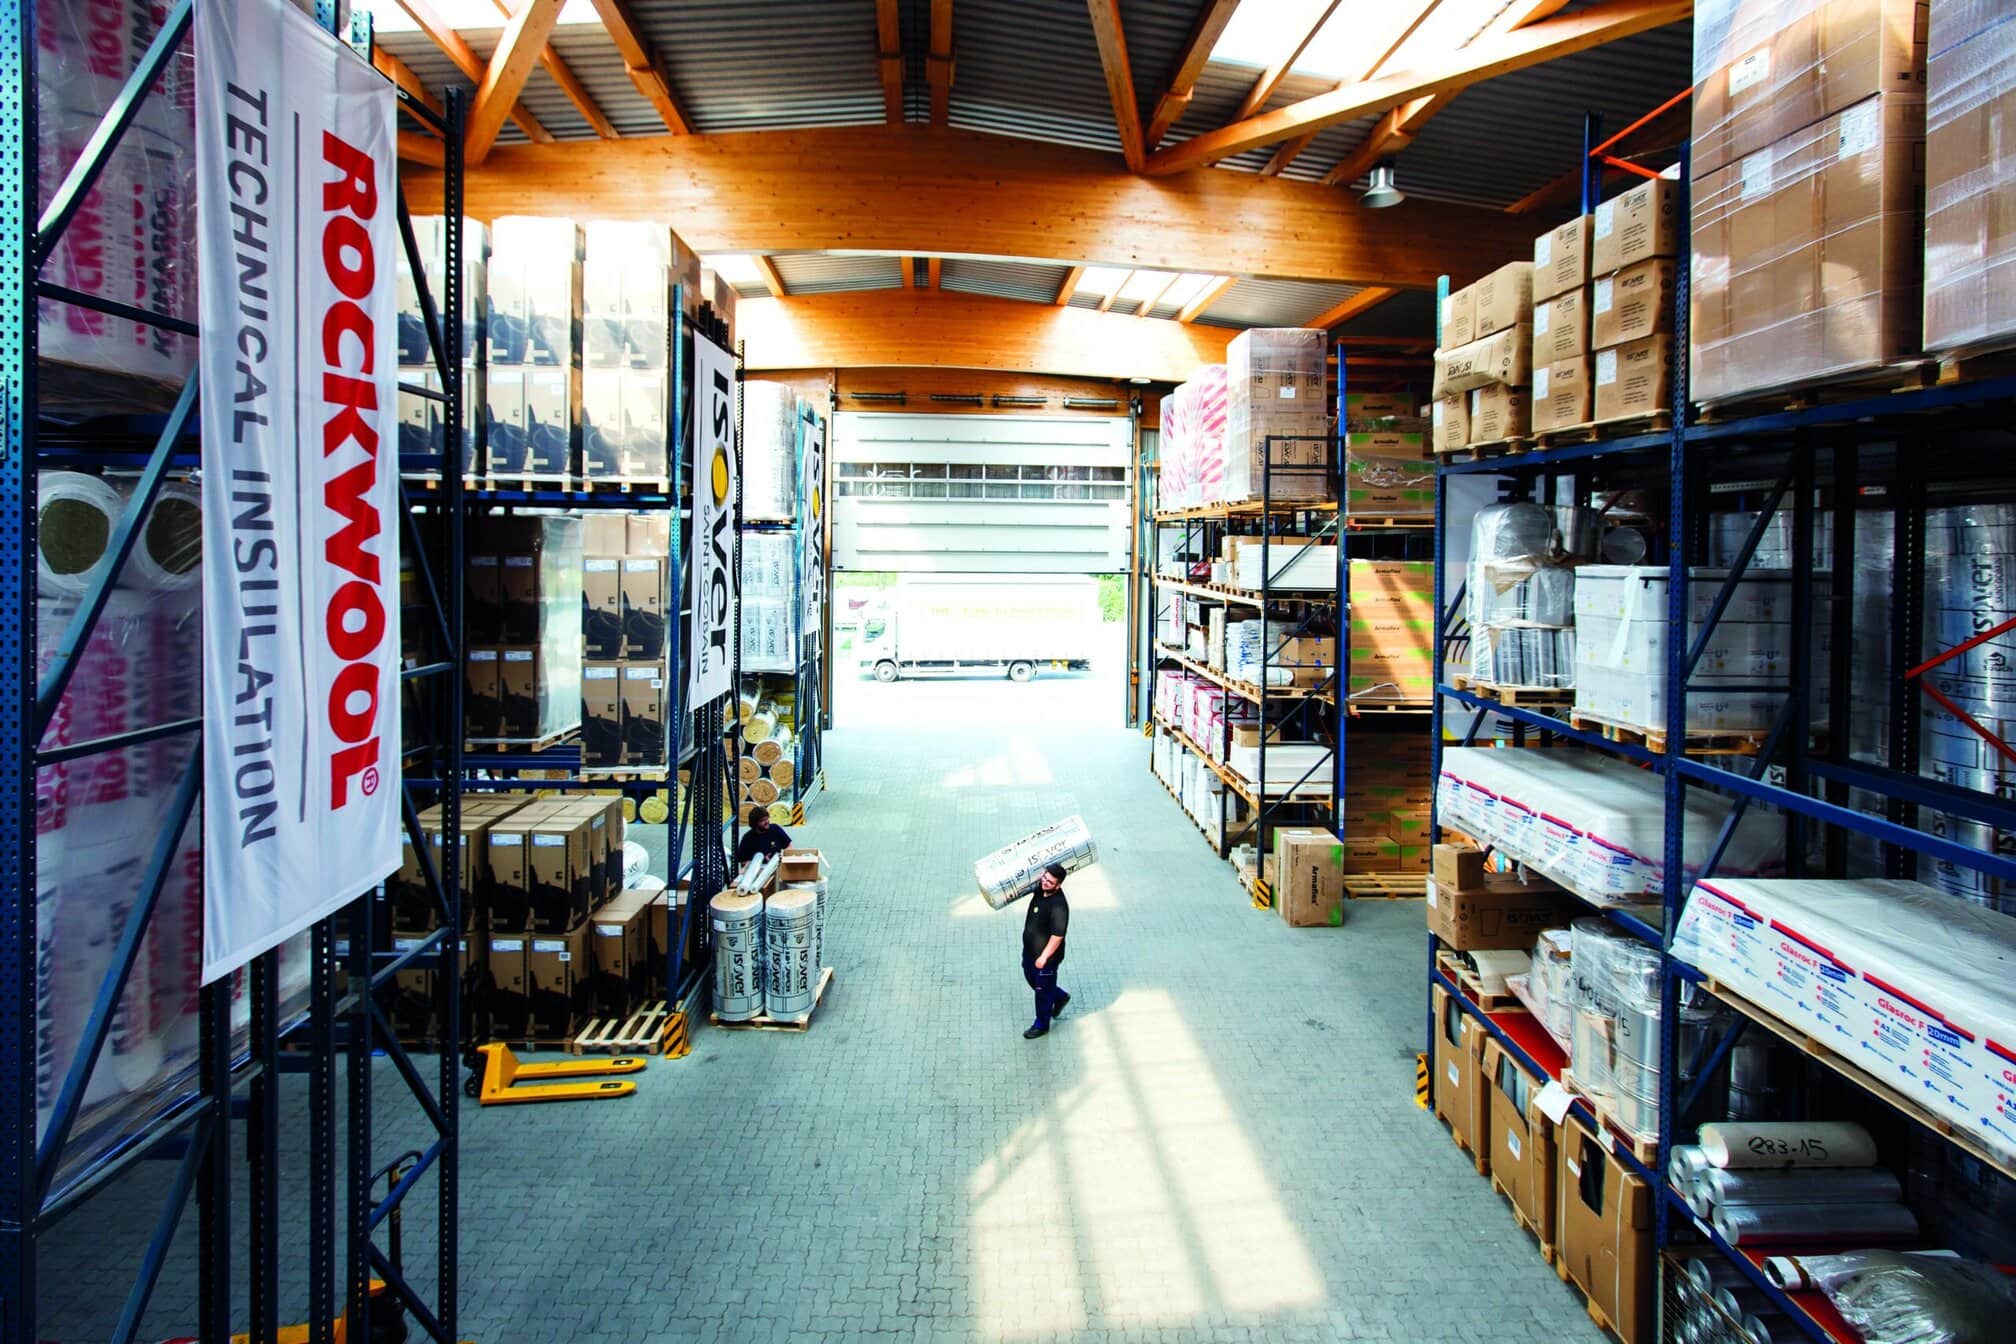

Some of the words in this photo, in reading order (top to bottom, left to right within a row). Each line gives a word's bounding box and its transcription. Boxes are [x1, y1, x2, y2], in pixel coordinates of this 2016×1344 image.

[225, 81, 270, 444] TECHNICAL
[232, 468, 279, 850] INSULATION
[702, 504, 711, 675] SAINT-GOBAIN
[1311, 865, 1320, 906] Armaflex
[1877, 997, 1917, 1027] Glasroc
[1928, 1027, 1961, 1049] 20mm
